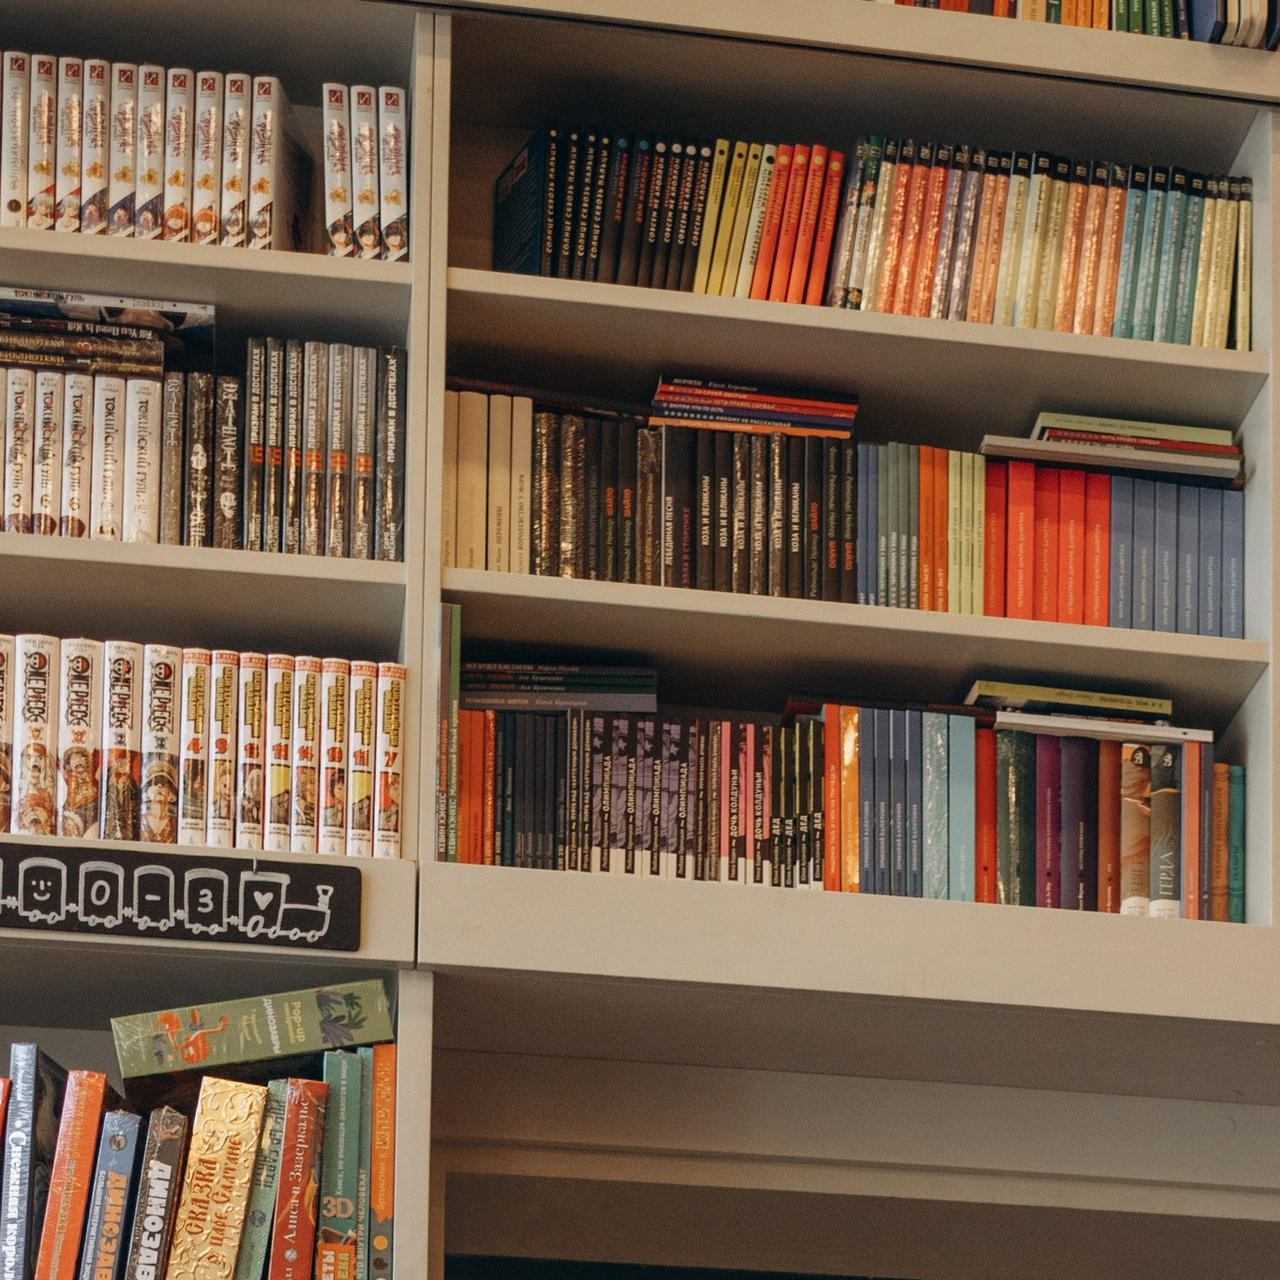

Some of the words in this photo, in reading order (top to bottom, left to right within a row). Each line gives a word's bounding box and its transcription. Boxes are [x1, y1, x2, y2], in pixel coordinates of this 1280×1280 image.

[648, 211, 658, 243] СОВСЕМ
[653, 199, 659, 209] НЕ
[252, 349, 260, 393] ДОСПЕХАХ
[387, 358, 397, 408] ДОСПЕХАХ
[251, 403, 259, 444] ПРИЗРАК
[387, 419, 396, 462] ПРИЗРАК
[665, 522, 673, 565] ЛЕБЕДИНАЯ
[187, 738, 203, 753] 4
[214, 738, 229, 753] 9
[384, 752, 398, 766] 7
[603, 755, 611, 812] ОЛИМПИАДА
[730, 769, 738, 814] КОЛДУНЬИ
[1157, 852, 1174, 896] ГЕРДА
[262, 997, 281, 1054] ДИНОЗАВРЫ
[7, 1131, 27, 1209] Снежная
[185, 1158, 218, 1236] СКАЗКА
[321, 1196, 354, 1219] 3D
[284, 1201, 300, 1244] Алиса
